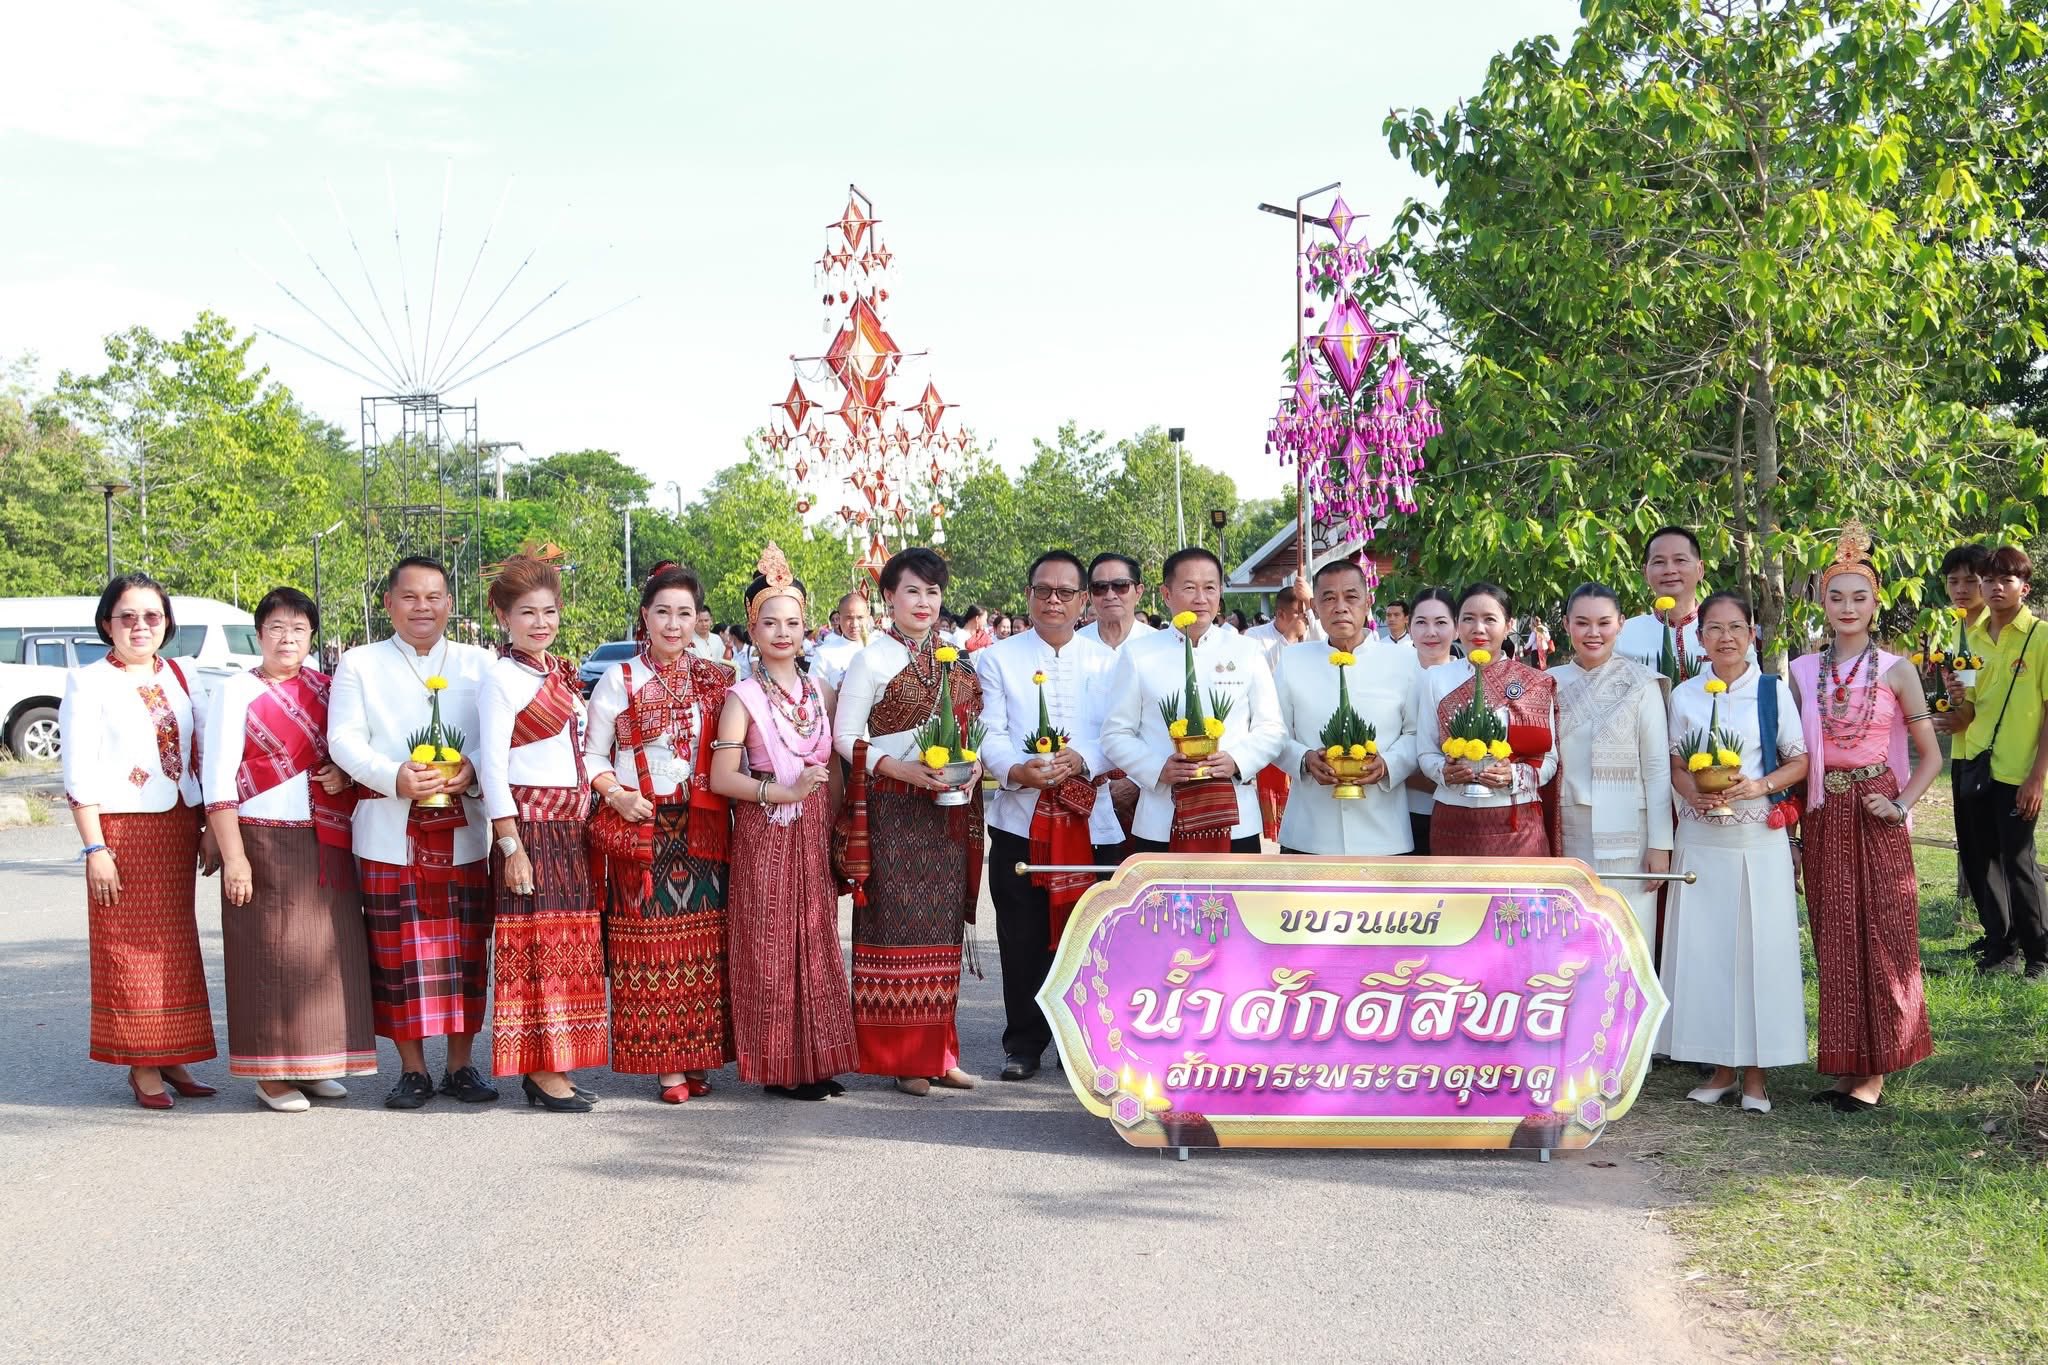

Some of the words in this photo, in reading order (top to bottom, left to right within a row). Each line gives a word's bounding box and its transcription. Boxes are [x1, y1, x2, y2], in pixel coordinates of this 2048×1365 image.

[1280, 899, 1445, 935] ขบวนแห่
[1128, 948, 1590, 1037] น้ำศักดิ์สิทธิ์
[1166, 1051, 1557, 1104] สักการะพระธาตุยาคู
